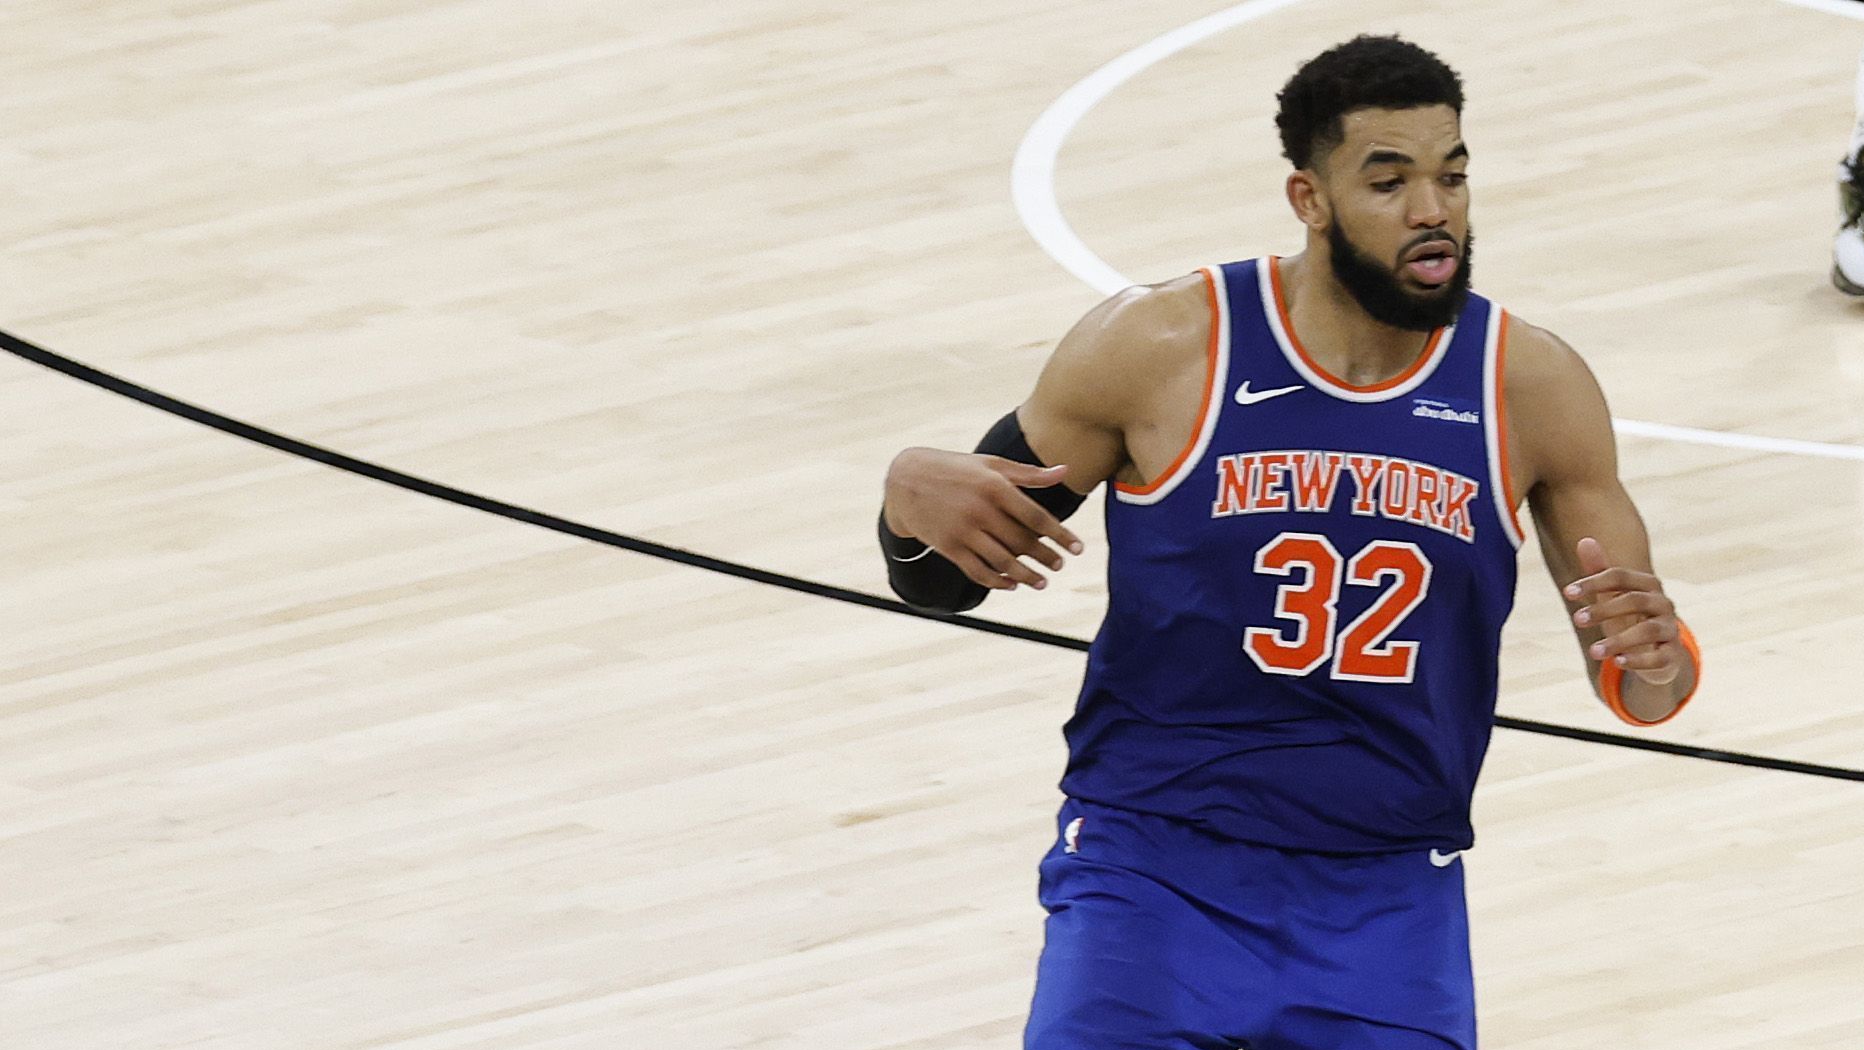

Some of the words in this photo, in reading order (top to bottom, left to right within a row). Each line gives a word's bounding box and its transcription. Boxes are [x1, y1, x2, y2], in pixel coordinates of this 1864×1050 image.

[1211, 449, 1342, 519] NEW
[1344, 450, 1480, 544] YORK
[1242, 531, 1434, 684] 32
